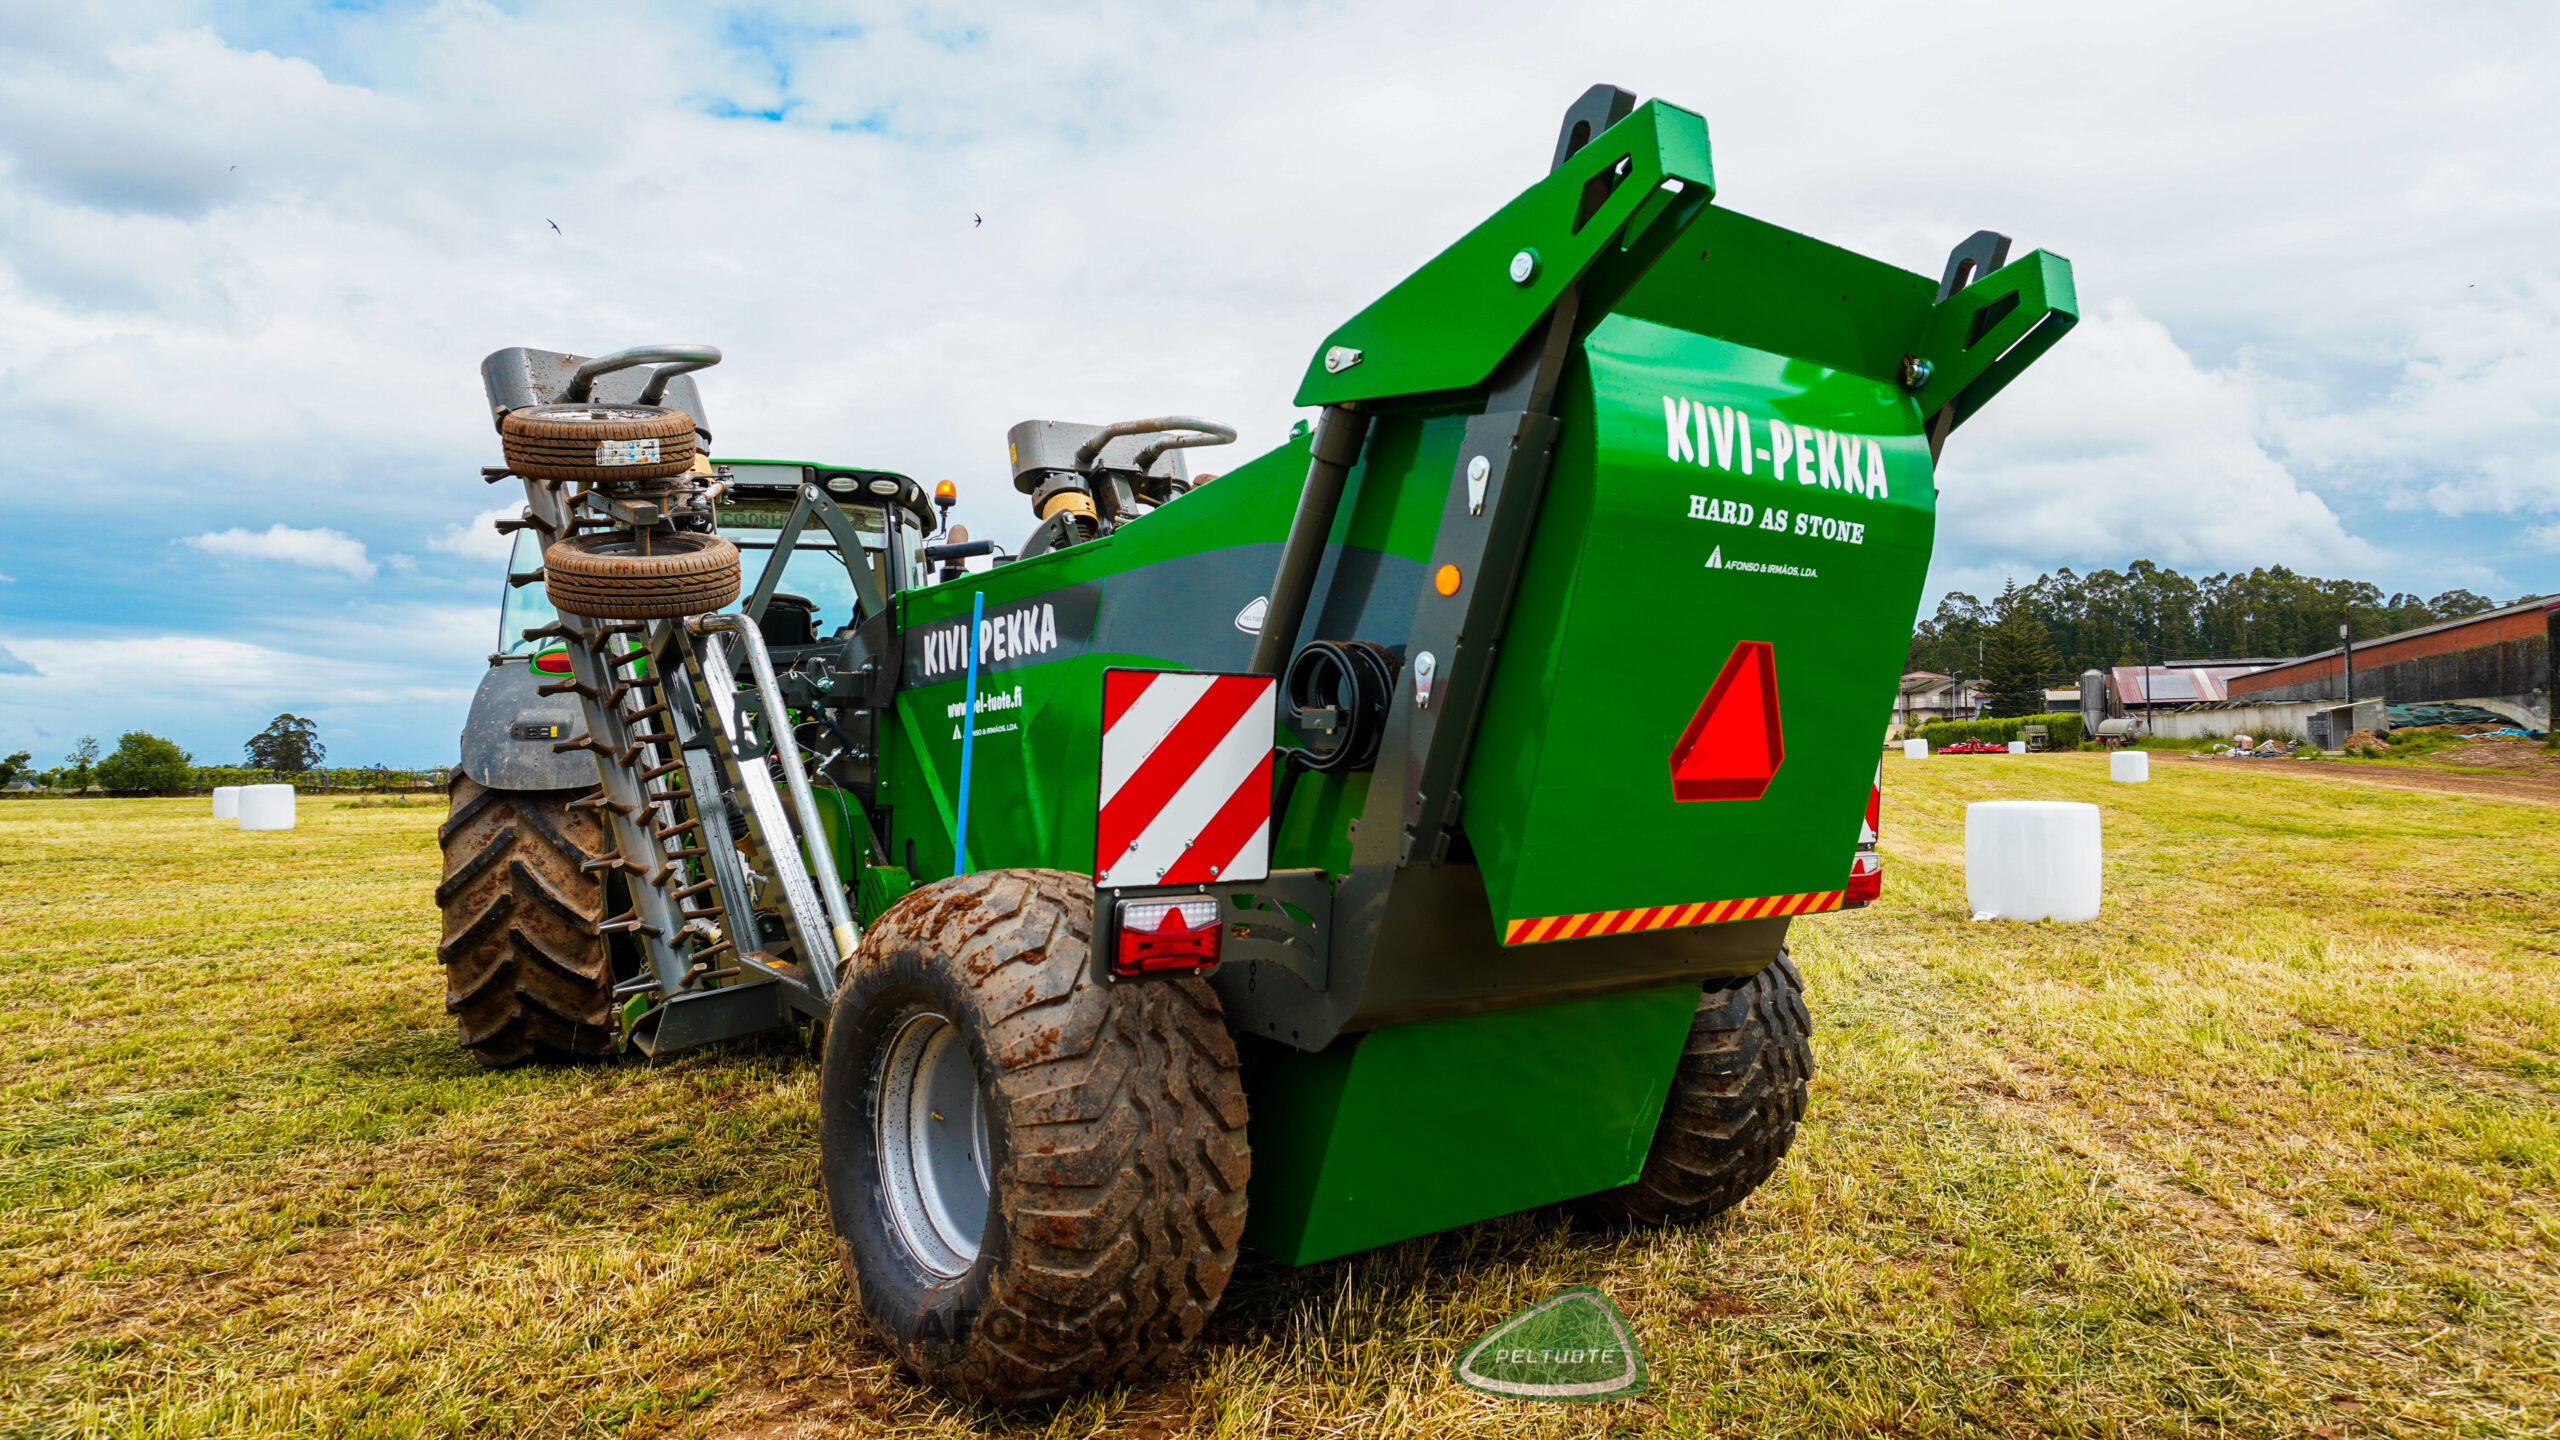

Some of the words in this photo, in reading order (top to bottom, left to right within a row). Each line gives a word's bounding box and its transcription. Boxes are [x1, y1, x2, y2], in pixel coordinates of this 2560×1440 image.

[1663, 395, 1888, 500] KIVI-PEKKA
[1687, 494, 1755, 526] HARD
[1759, 507, 1789, 533] AS
[1794, 514, 1865, 545] STONE
[1724, 560, 1760, 573] AFONSO
[1760, 564, 1767, 573] &
[1800, 568, 1819, 578] LDA.
[923, 603, 1058, 677] KIVIPEKKA
